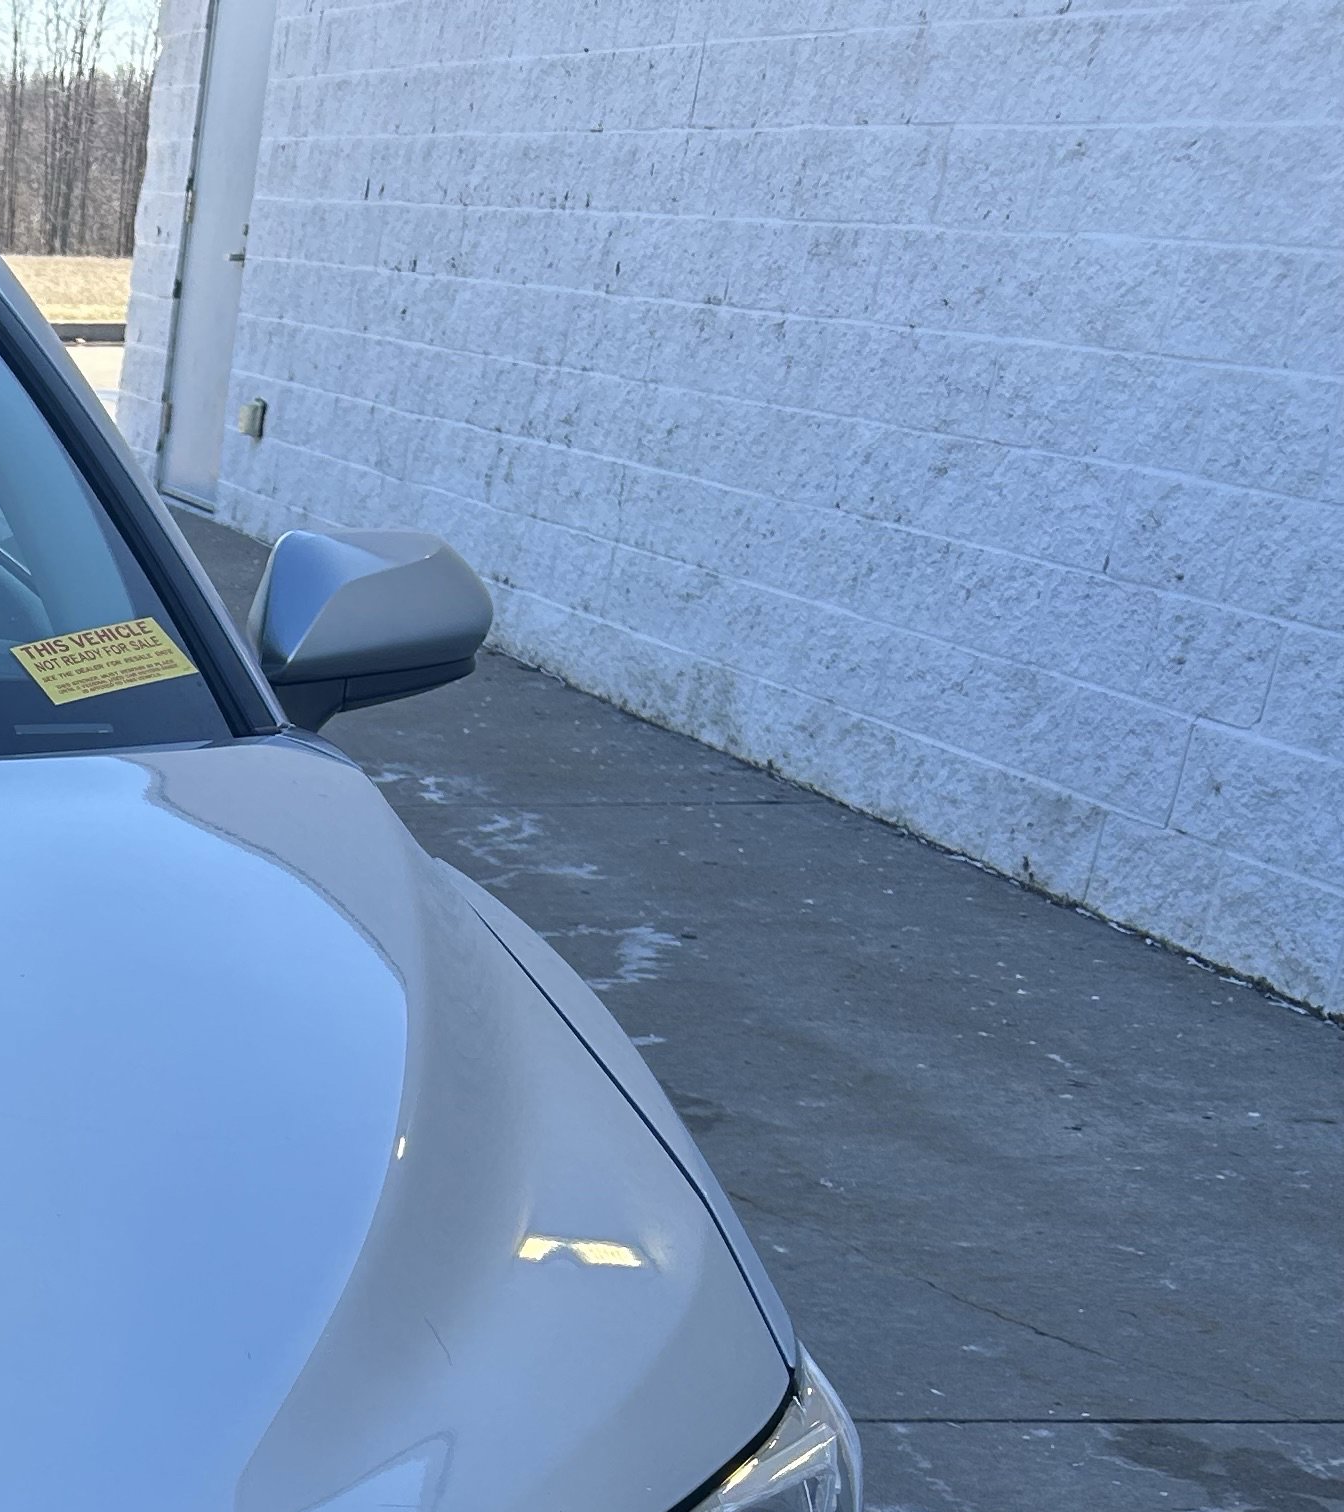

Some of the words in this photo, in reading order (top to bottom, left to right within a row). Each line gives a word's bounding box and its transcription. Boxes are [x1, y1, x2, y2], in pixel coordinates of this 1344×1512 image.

[20, 639, 70, 660] THIS
[68, 620, 154, 649] VEHICLE
[33, 658, 62, 673] NOT
[60, 648, 103, 667] READY
[101, 642, 129, 657] FOR
[131, 635, 163, 651] SALE
